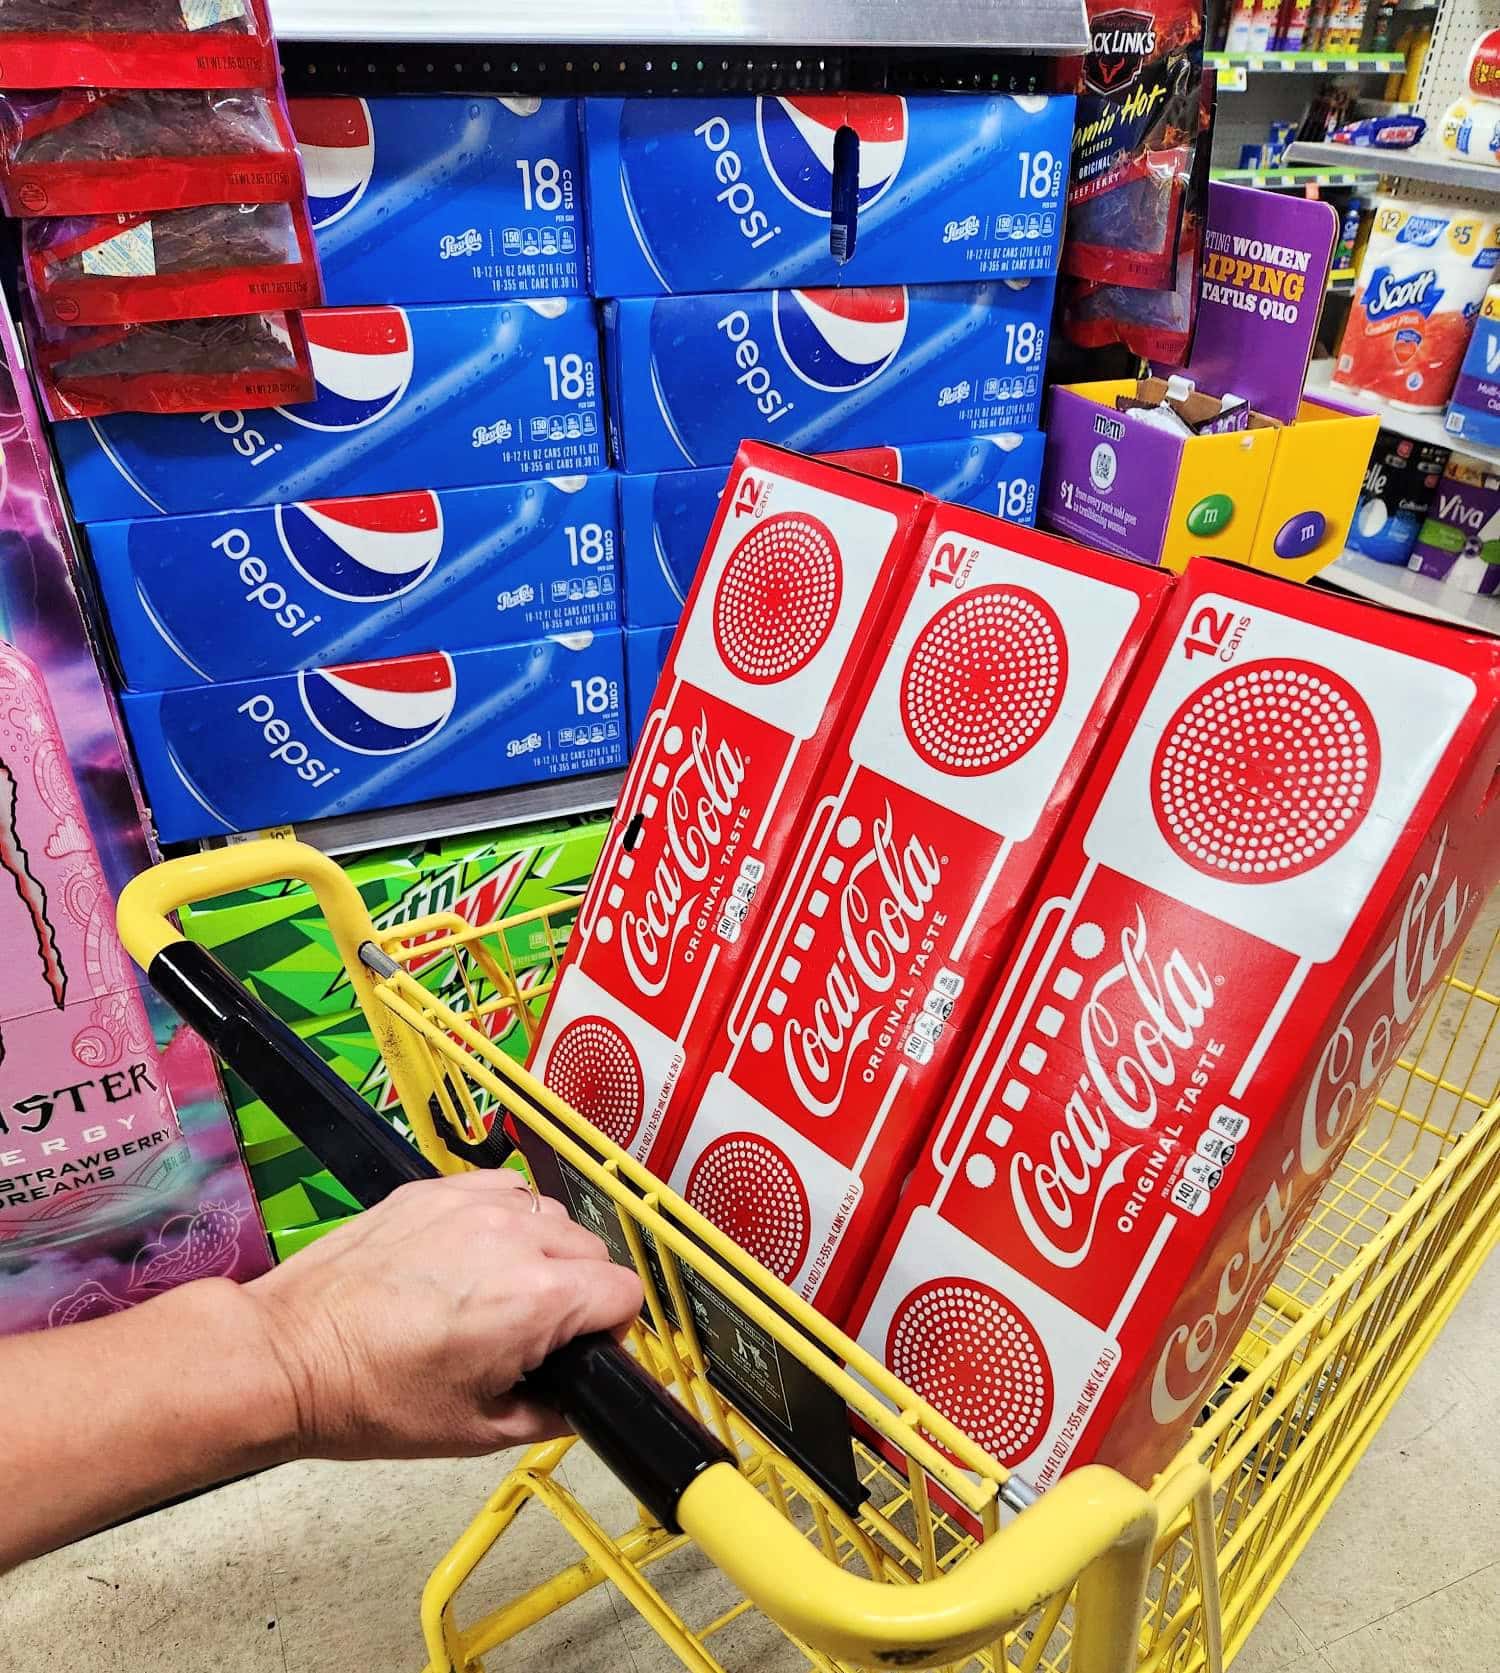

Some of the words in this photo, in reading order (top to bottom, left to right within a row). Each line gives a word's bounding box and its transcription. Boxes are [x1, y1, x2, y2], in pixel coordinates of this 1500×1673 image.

[1121, 83, 1167, 125] Hot
[516, 159, 562, 211] 18
[694, 116, 781, 249] pepsi
[1019, 150, 1053, 199] 18
[1051, 160, 1062, 198] cans
[1078, 155, 1111, 180] ORIGINAL
[1091, 171, 1120, 192] JERKY
[563, 169, 574, 210] cans
[504, 231, 520, 243] 150
[1381, 210, 1400, 232] 12
[1454, 226, 1473, 245] $5
[517, 264, 536, 277] CANS
[1233, 236, 1311, 272] WOMEN
[531, 278, 549, 290] CANS
[1203, 253, 1305, 302] IPPING
[1369, 269, 1436, 315] Scott
[1202, 281, 1258, 313] TATUS
[1259, 298, 1298, 324] QUO
[1484, 299, 1493, 316] 6
[1005, 321, 1036, 365] 18
[1034, 329, 1044, 362] cans
[543, 353, 585, 401] 18
[585, 361, 595, 398] cans
[716, 310, 794, 424] pepsi
[735, 477, 763, 519] 12
[755, 482, 775, 519] Cans
[997, 478, 1028, 518] 18
[1060, 480, 1073, 510] $1
[1439, 494, 1484, 528] Viva
[1203, 508, 1219, 524] m
[1301, 524, 1315, 542] m
[564, 523, 604, 566] 18
[604, 529, 614, 561] cans
[211, 528, 321, 637] pepsi
[929, 542, 967, 589] 12
[954, 550, 980, 590] Cans
[1184, 607, 1234, 660] 12
[1220, 616, 1251, 662] Cans
[571, 676, 609, 715] 18
[609, 681, 618, 710] cans
[237, 694, 341, 788] pepsi
[621, 707, 745, 998] Coca-Cola
[684, 874, 726, 963] ORIGINAL
[720, 805, 751, 866] TASTE
[719, 918, 731, 935] 140
[783, 797, 941, 1118] Coca-Cola
[863, 985, 915, 1083] ORIGINAL
[908, 912, 948, 979] TASTE
[907, 1036, 922, 1055] 140
[1009, 903, 1215, 1269] Coca-Cola
[0, 1115, 136, 1167] ERGY
[1117, 1123, 1184, 1233] ORIGINAL
[1175, 1037, 1226, 1116] TASTE
[1151, 822, 1468, 1425] Coca-Cola
[0, 1127, 171, 1193] STRAWBERRY
[1175, 1182, 1194, 1204] 140
[804, 1281, 815, 1295] FL
[815, 1243, 833, 1269] 12-355
[832, 1213, 846, 1234] CANS
[1090, 1357, 1111, 1383] (4.26
[1076, 1401, 1090, 1417] mL
[1080, 1380, 1100, 1403] CANS
[1061, 1411, 1083, 1441] 12-355
[1038, 1462, 1053, 1488] (144
[1049, 1455, 1061, 1469] FL
